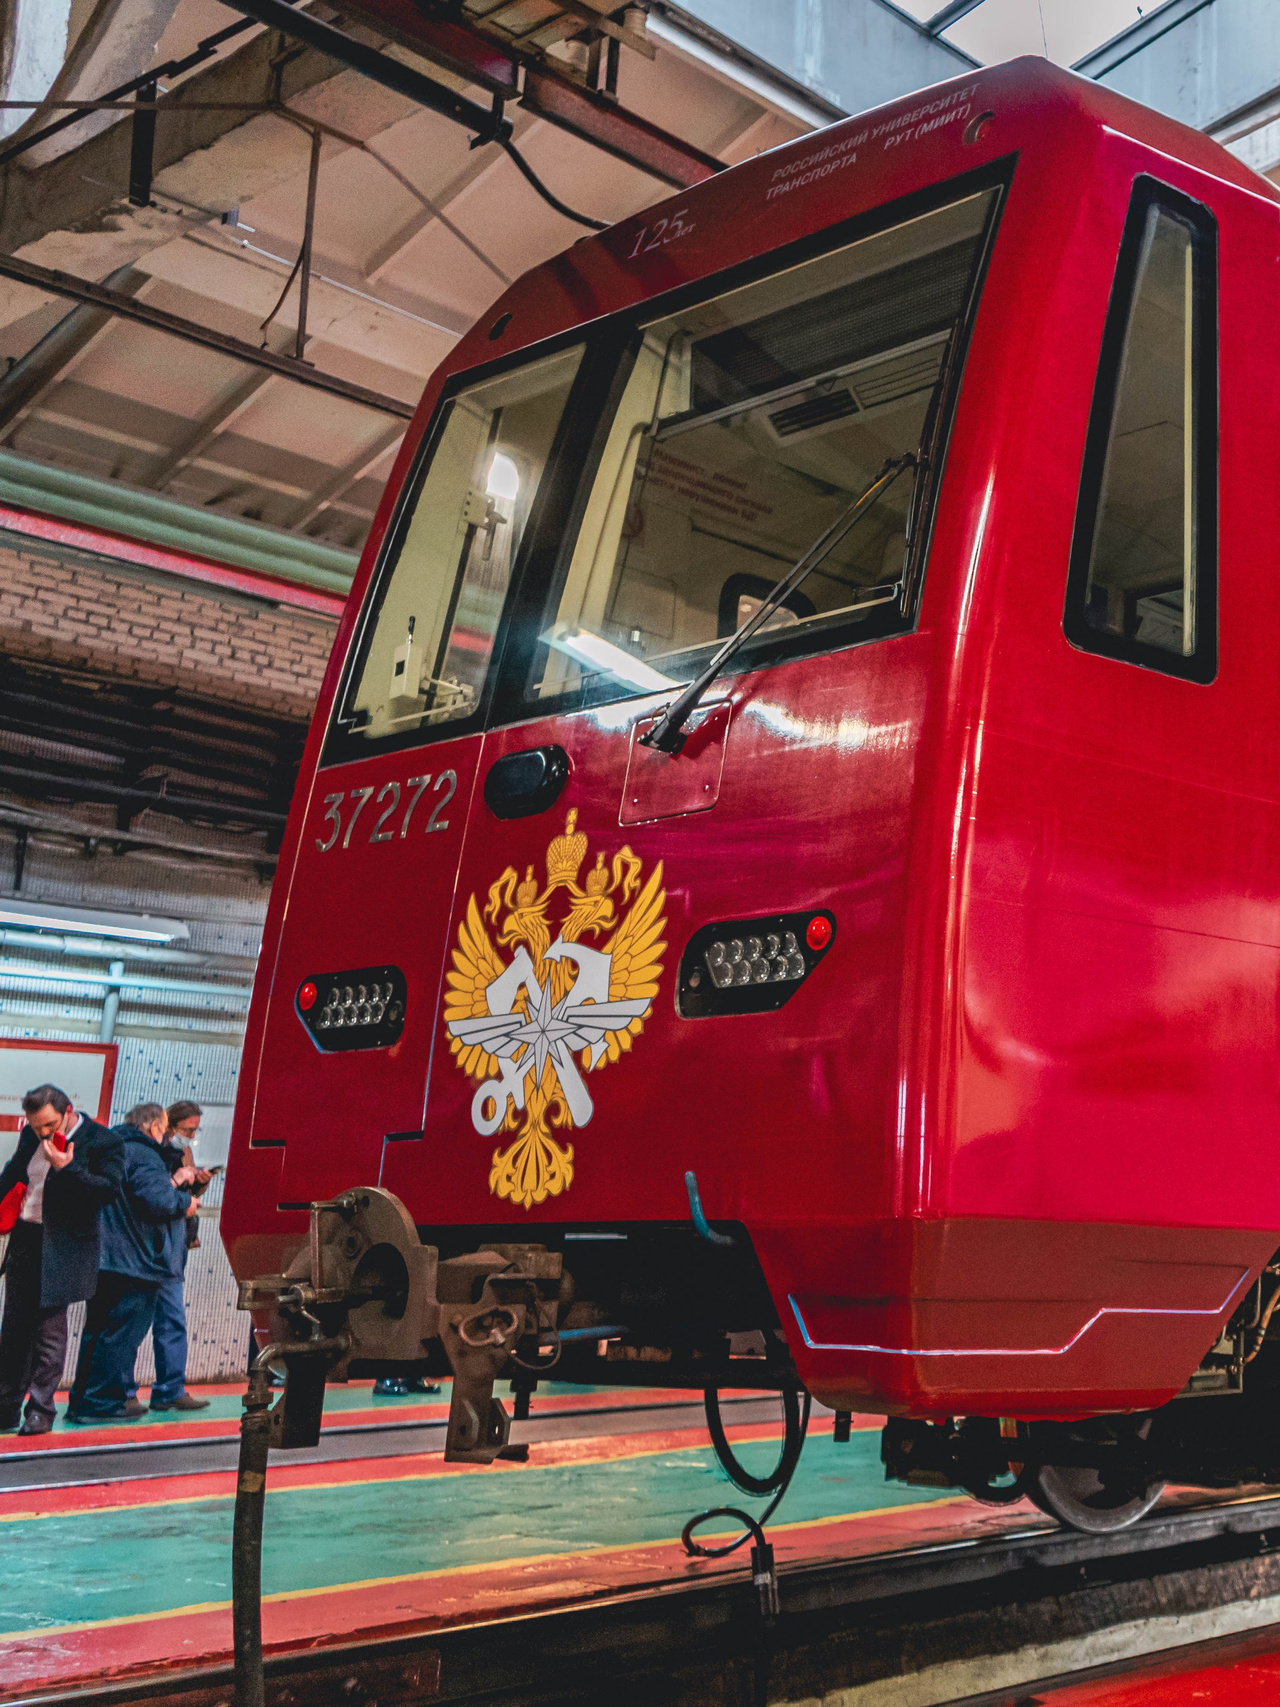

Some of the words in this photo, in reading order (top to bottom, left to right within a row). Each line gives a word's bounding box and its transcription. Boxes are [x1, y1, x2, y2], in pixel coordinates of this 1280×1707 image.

[766, 152, 857, 200] ТРАНСПОРТА
[883, 128, 914, 150] РУТ
[914, 102, 971, 140] (МИИТ)
[771, 129, 869, 181] РОССИЙСКИЙ
[871, 82, 981, 139] УНИВЕРСИТЕТ
[627, 208, 689, 260] 125
[315, 768, 458, 853] 37272
